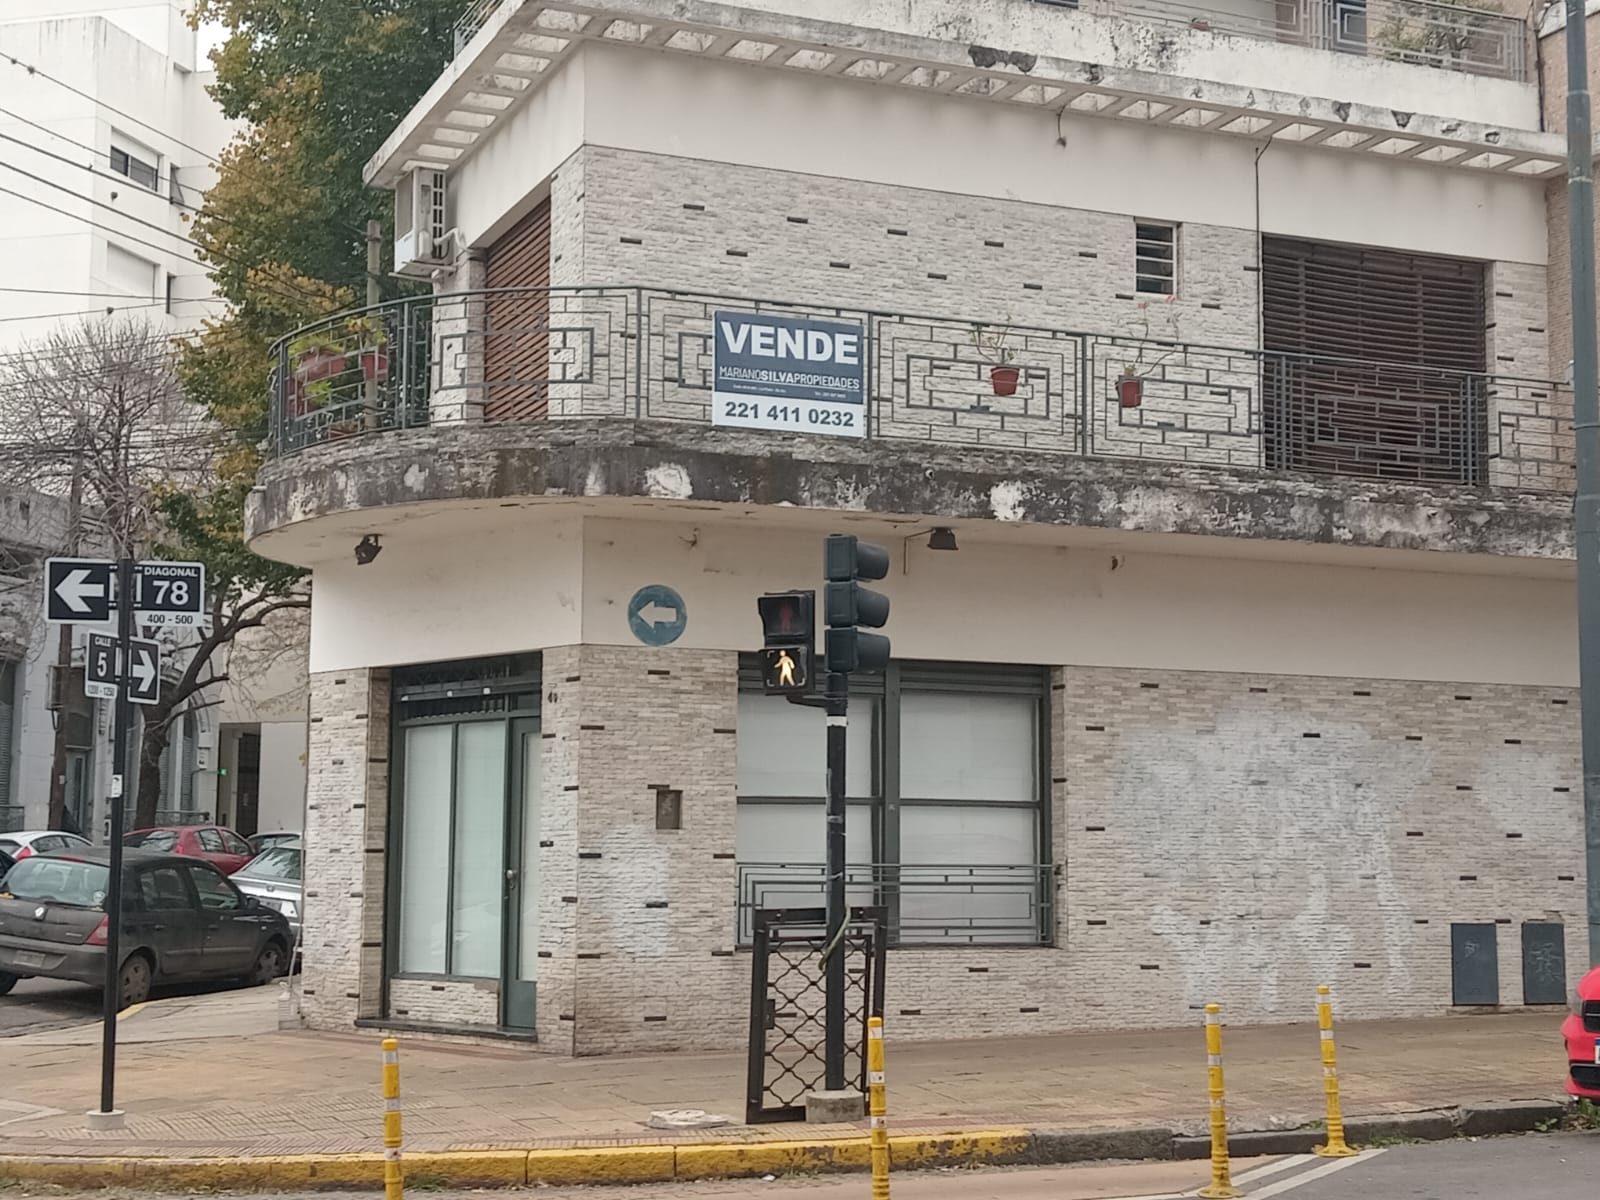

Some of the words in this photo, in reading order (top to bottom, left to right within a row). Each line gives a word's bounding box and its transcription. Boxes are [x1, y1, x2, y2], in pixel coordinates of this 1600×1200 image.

[720, 321, 859, 365] VENDE
[719, 366, 860, 389] MARIANOSILVAPROPIEDADES
[725, 401, 759, 419] 221
[767, 405, 800, 422] 411
[808, 409, 854, 427] 0232
[144, 566, 198, 577] DIAGONAL
[153, 580, 189, 605] 78
[147, 614, 165, 624] 400
[175, 615, 193, 624] 500
[97, 651, 107, 677] 5
